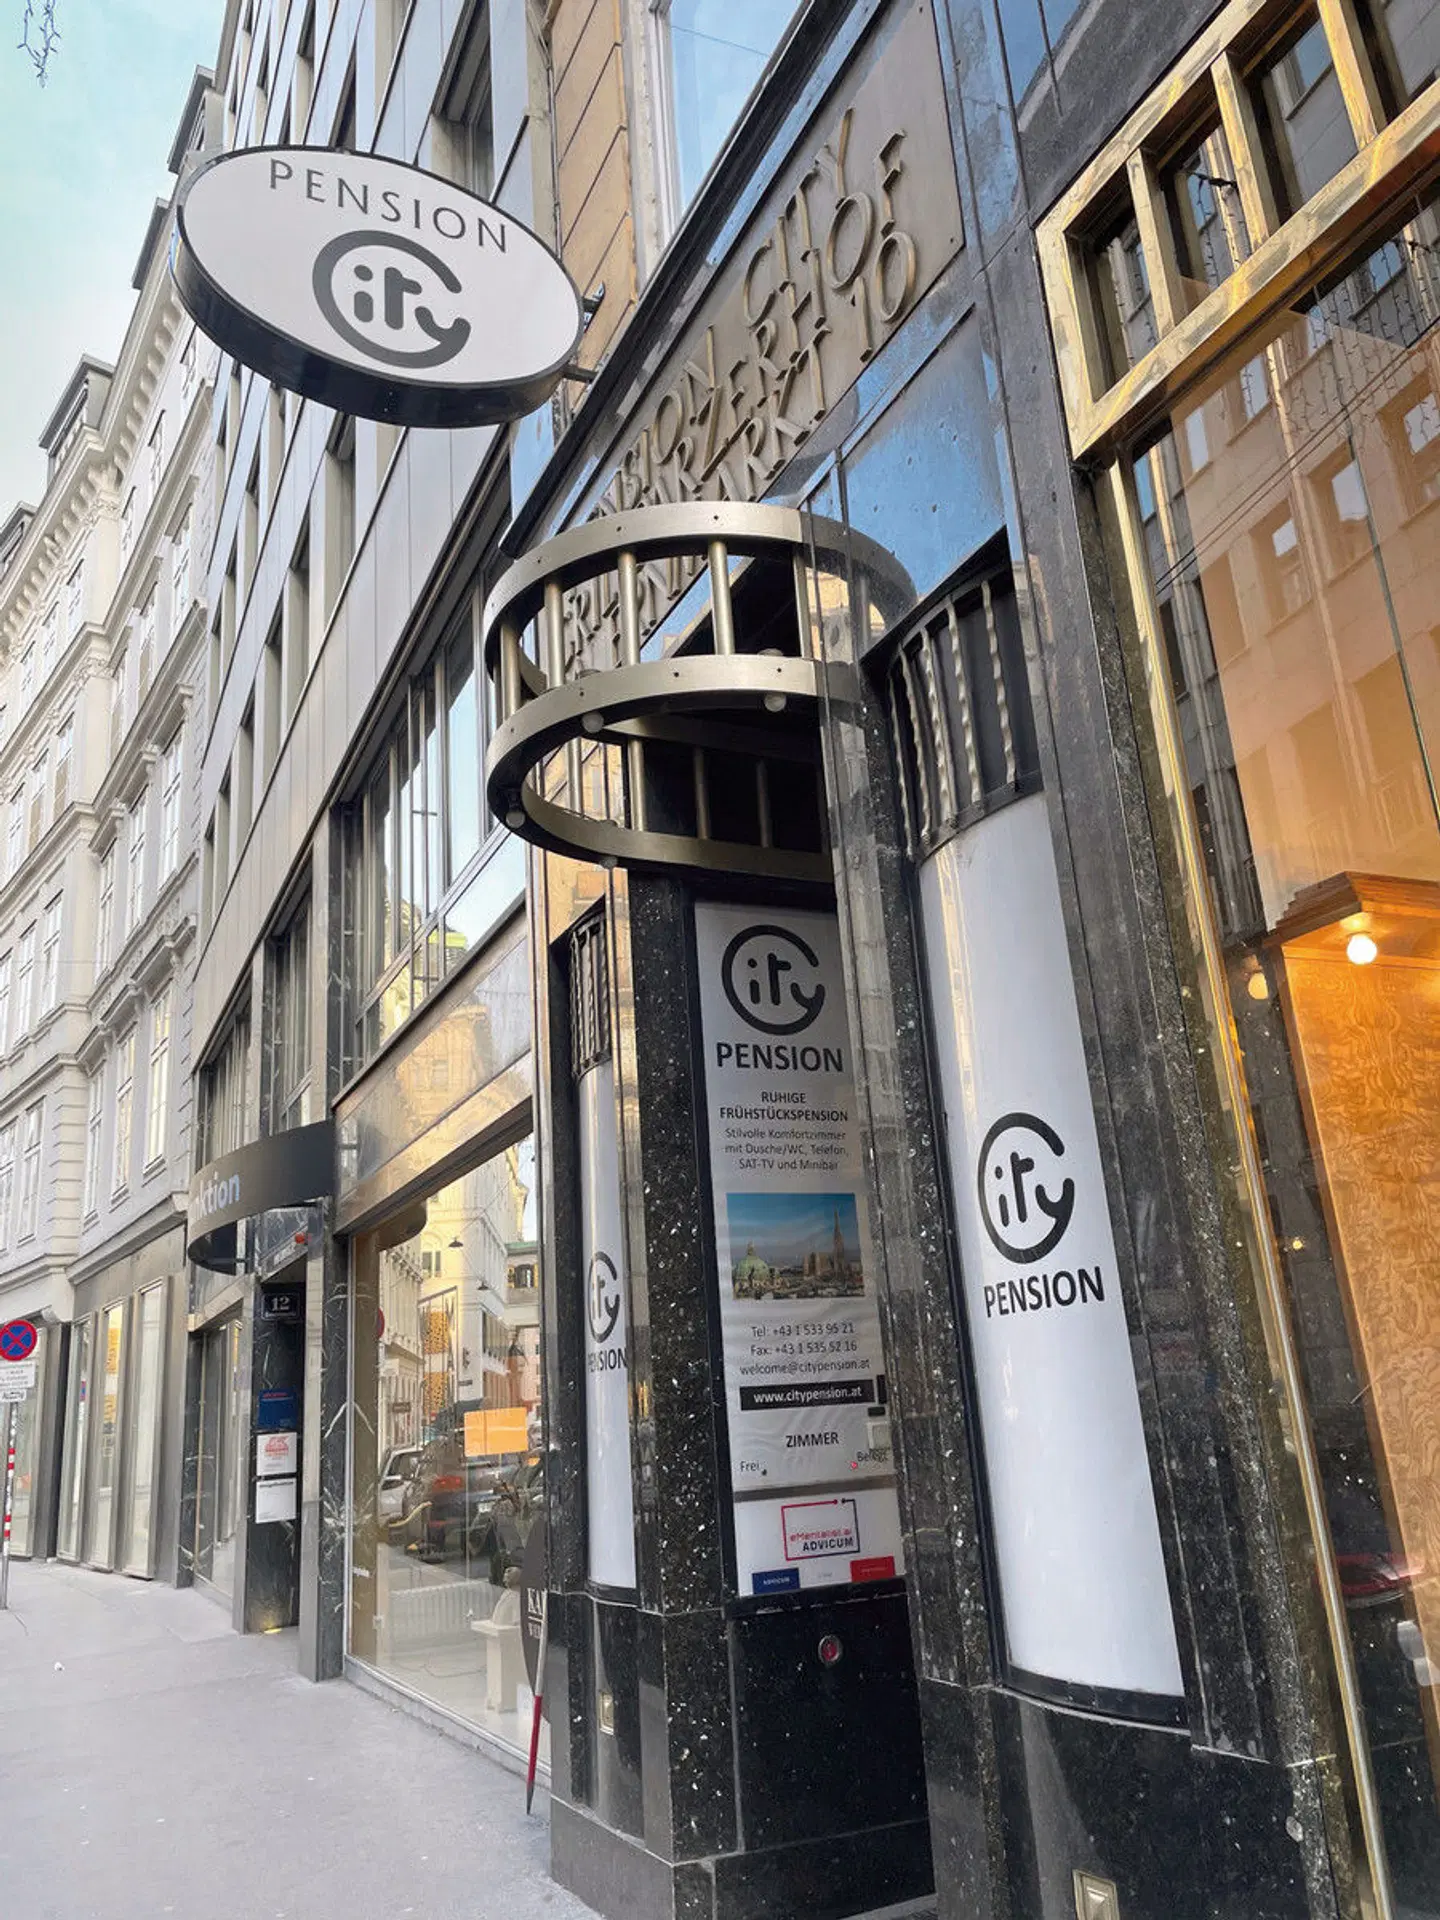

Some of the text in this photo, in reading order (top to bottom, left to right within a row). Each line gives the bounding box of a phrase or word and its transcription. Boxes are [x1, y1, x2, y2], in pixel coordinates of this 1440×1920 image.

[270, 158, 508, 254] PENSION
[851, 231, 917, 362] 10
[588, 106, 855, 520] NSION CITY
[716, 1041, 844, 1073] PENSION
[761, 1090, 806, 1104] RUHIGE
[719, 1104, 848, 1122] FRÜHSTÜCKSPENSION
[724, 1144, 742, 1154] mit
[739, 1159, 774, 1170] SAT-TV
[777, 1160, 797, 1170] und
[984, 1265, 1106, 1319] PENSION
[272, 1296, 290, 1312] 12
[773, 1325, 793, 1337] +43
[795, 1325, 802, 1336] 1
[803, 1323, 824, 1336] 533
[842, 1322, 856, 1334] 21
[775, 1344, 796, 1356] +43
[798, 1343, 804, 1355] 1
[806, 1342, 827, 1354] 535
[844, 1340, 858, 1352] 16
[740, 1359, 871, 1376] welcome@citypension.at
[752, 1385, 863, 1404] www.citypension.at
[785, 1432, 840, 1448] ZIMMER
[740, 1461, 760, 1473] Frei
[802, 1537, 854, 1552] ADVICUM
